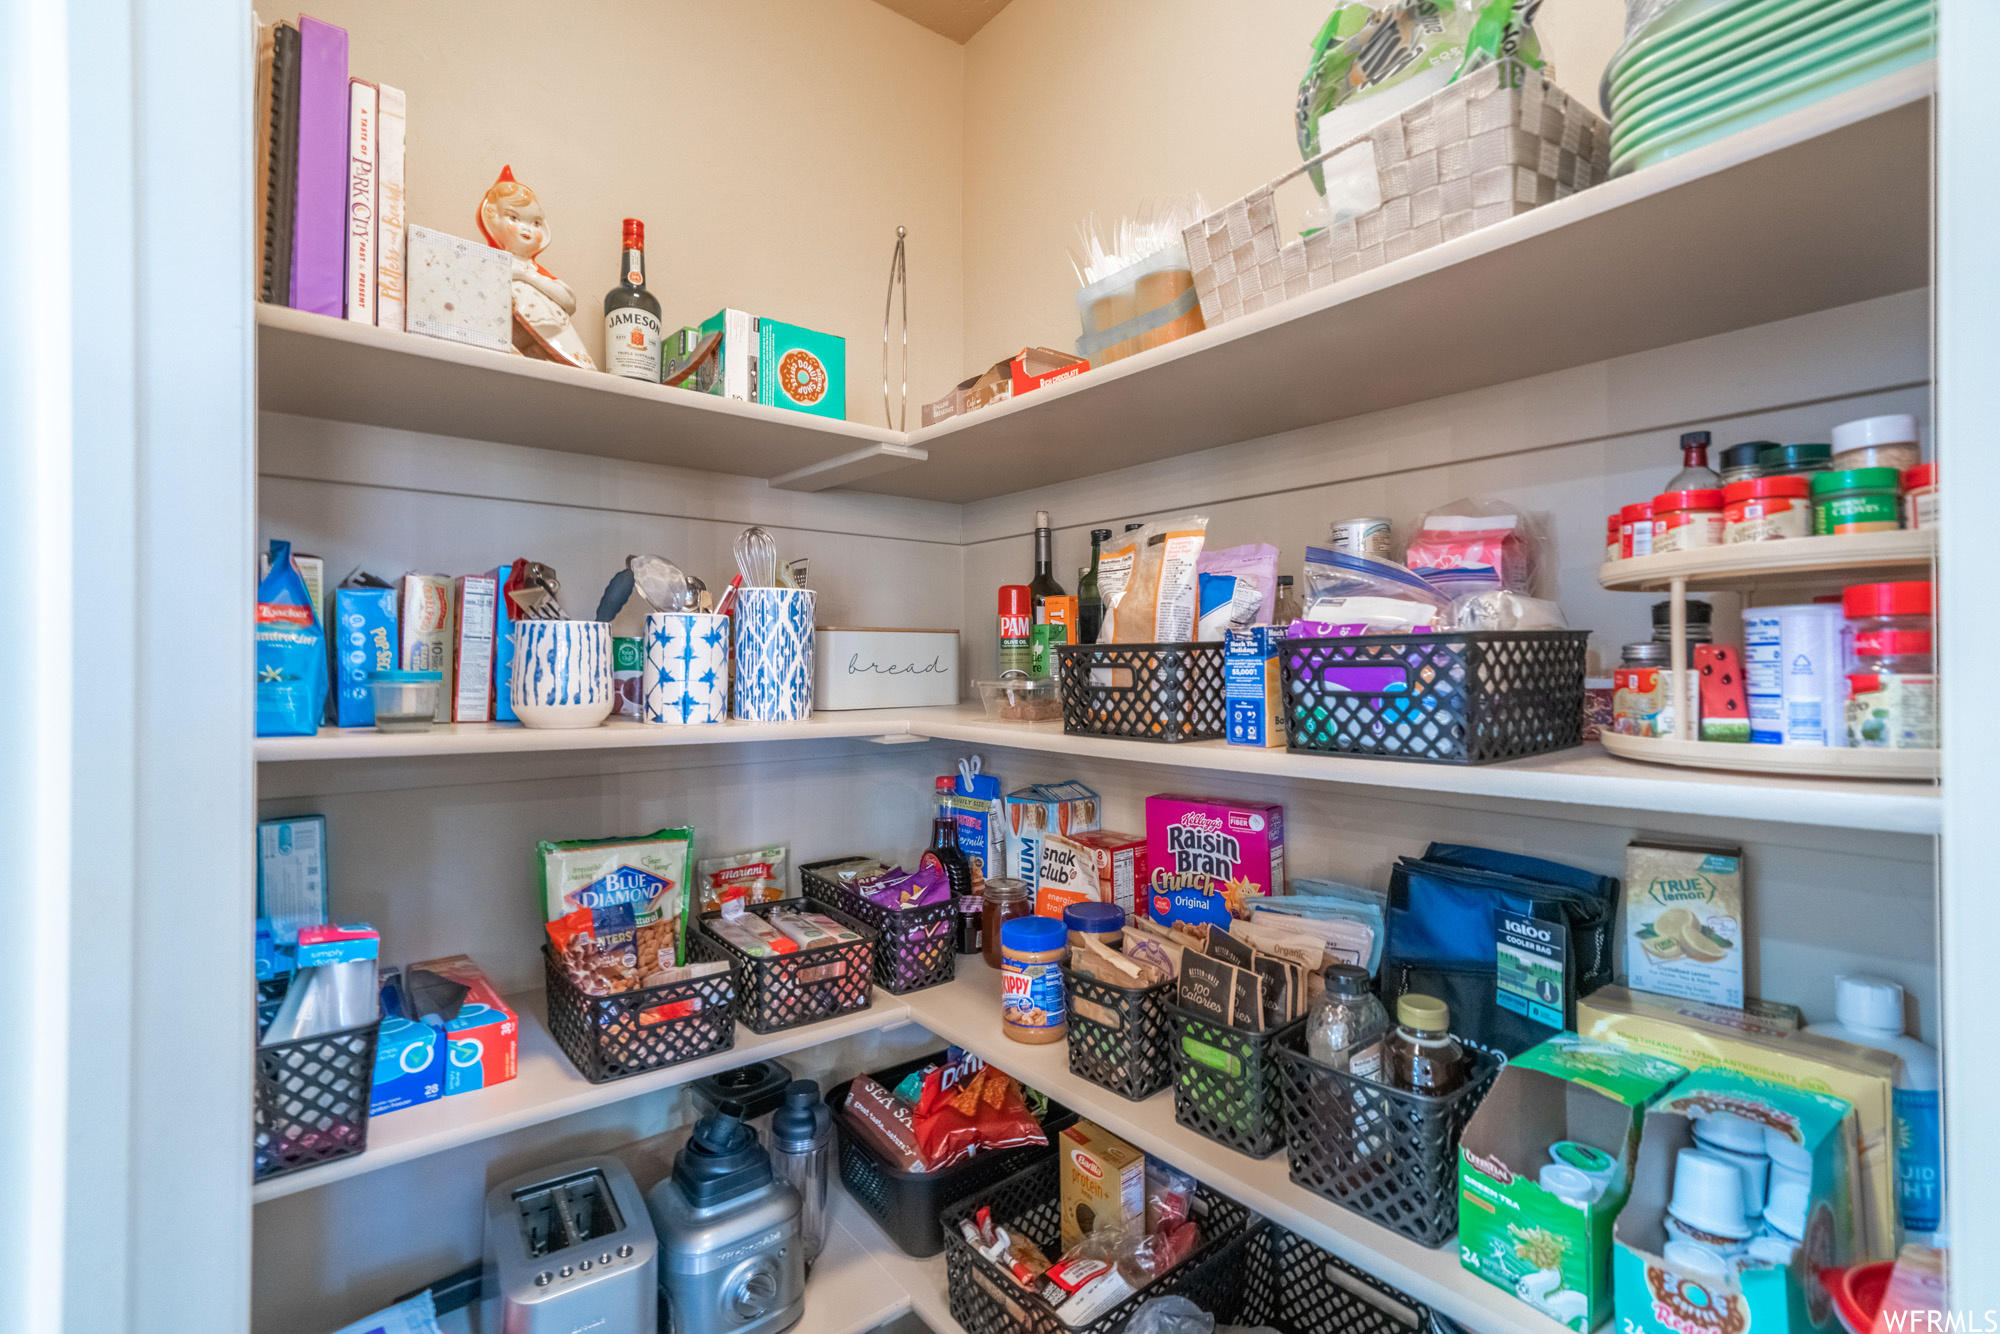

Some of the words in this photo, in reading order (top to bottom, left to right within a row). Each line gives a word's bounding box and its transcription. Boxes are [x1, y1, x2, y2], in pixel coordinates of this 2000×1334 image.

[360, 118, 368, 142] TASTE
[360, 144, 368, 156] OF
[352, 156, 373, 201] PARK
[351, 202, 372, 242] CITY
[358, 242, 366, 262] PAST
[358, 272, 366, 309] PRESENT
[608, 313, 661, 337] JAMESON
[789, 362, 798, 388] COFFEE
[798, 359, 820, 385] DONUT
[815, 368, 826, 394] ORIGINAL
[1052, 368, 1079, 384] CHOCOLATE
[798, 382, 816, 394] SHOP
[933, 400, 949, 410] ENGLISH
[933, 406, 954, 418] BREAKFAST
[1832, 504, 1879, 516] CLOVES
[1000, 616, 1030, 636] PAM
[256, 631, 318, 647] uadratini
[432, 640, 443, 655] 10
[849, 653, 948, 675] bread
[973, 800, 984, 808] SIZE
[1181, 812, 1223, 832] Kellogg's
[1230, 819, 1248, 827] FIBER
[1168, 825, 1239, 862] Raisin
[1043, 848, 1076, 868] snak
[1098, 850, 1102, 860] 8
[721, 864, 764, 880] Mariani
[1040, 864, 1069, 885] club
[1178, 850, 1232, 882] Bran
[606, 874, 647, 892] BLUE
[1151, 867, 1215, 897] Crunch
[1658, 878, 1703, 893] TRUE
[582, 882, 662, 908] DIAMOND
[1175, 896, 1210, 910] Original
[1663, 890, 1706, 902] lemon
[636, 912, 659, 925] atural
[1504, 919, 1550, 942] IGLOO
[311, 949, 344, 958] simply
[1274, 944, 1306, 960] Organic
[1506, 934, 1534, 950] COOLER
[1536, 944, 1552, 956] BAG
[1690, 970, 1711, 978] Lemon
[1002, 976, 1030, 995] KIPPY
[1194, 982, 1210, 997] 100
[1181, 986, 1223, 1013] Calories
[500, 1022, 512, 1036] 38
[424, 1083, 440, 1096] 28
[853, 1100, 870, 1116] great
[865, 1082, 895, 1110] SEA
[893, 1107, 915, 1132] SA
[1078, 1156, 1101, 1176] Barilla
[1464, 1174, 1498, 1199] GREEN
[1498, 1194, 1520, 1210] TEA
[1462, 1246, 1480, 1268] 24
